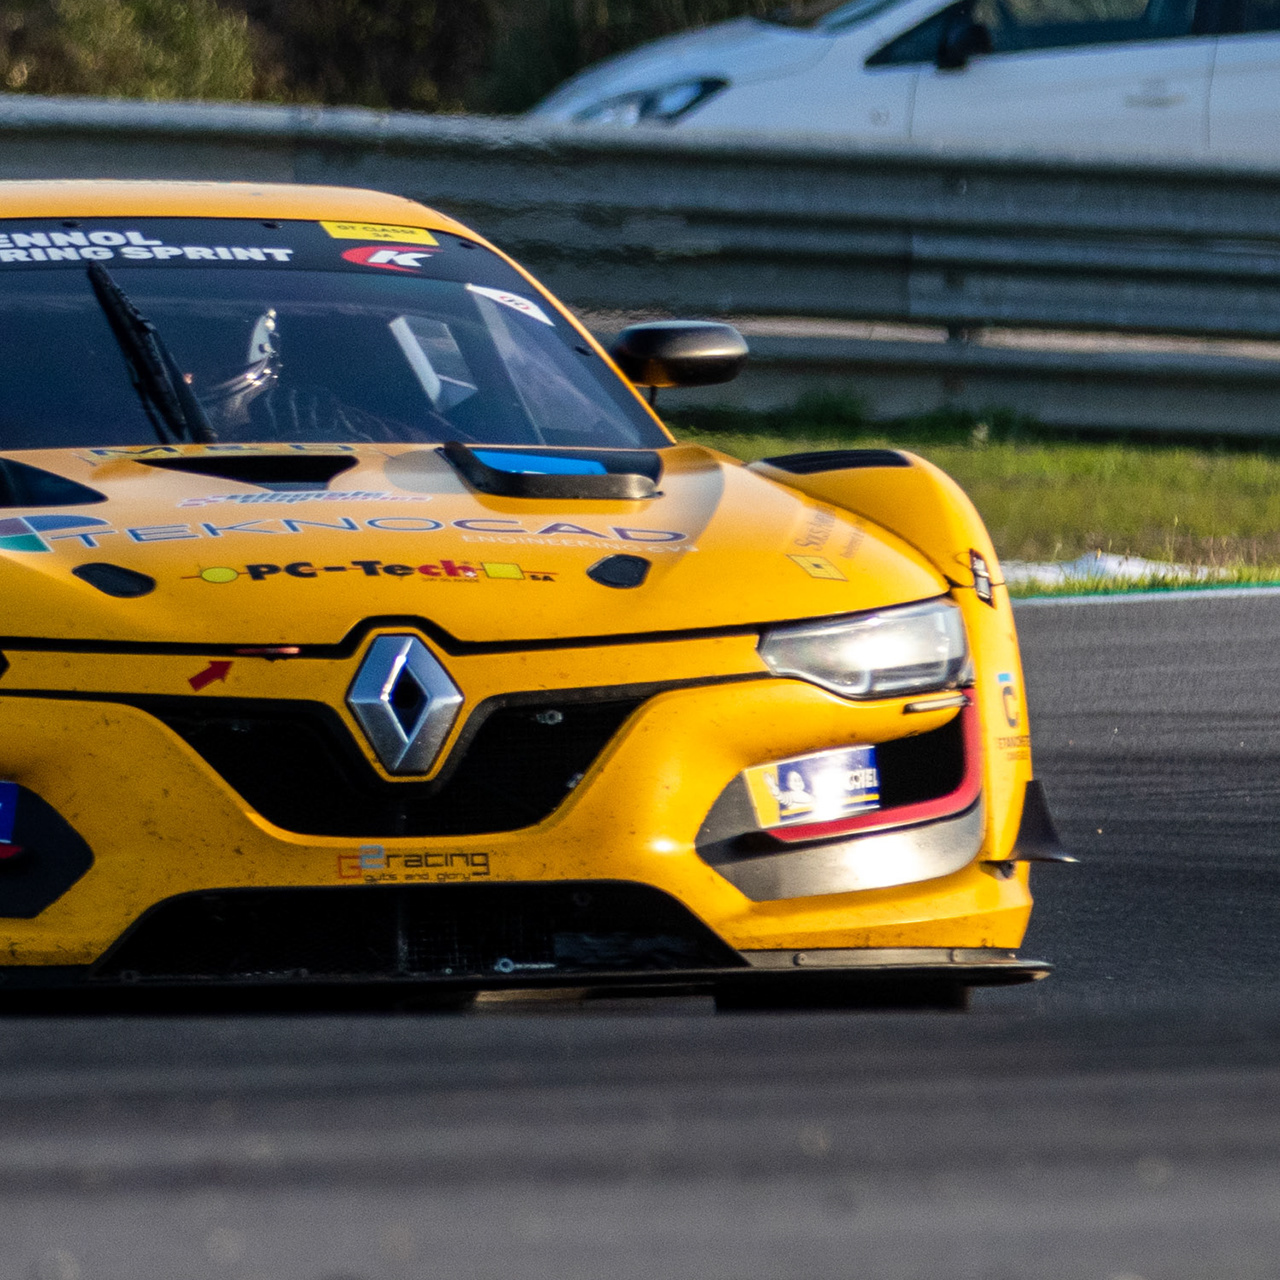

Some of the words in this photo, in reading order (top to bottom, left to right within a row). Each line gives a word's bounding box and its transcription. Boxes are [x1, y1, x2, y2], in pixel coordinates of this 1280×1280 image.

[122, 245, 294, 262] SPRINT
[48, 516, 688, 549] TEKNOCAD
[462, 534, 642, 552] ENGINEERING
[244, 558, 477, 581] PC-Tech
[364, 872, 398, 884] guts
[404, 872, 430, 881] and
[436, 871, 472, 883] glory
